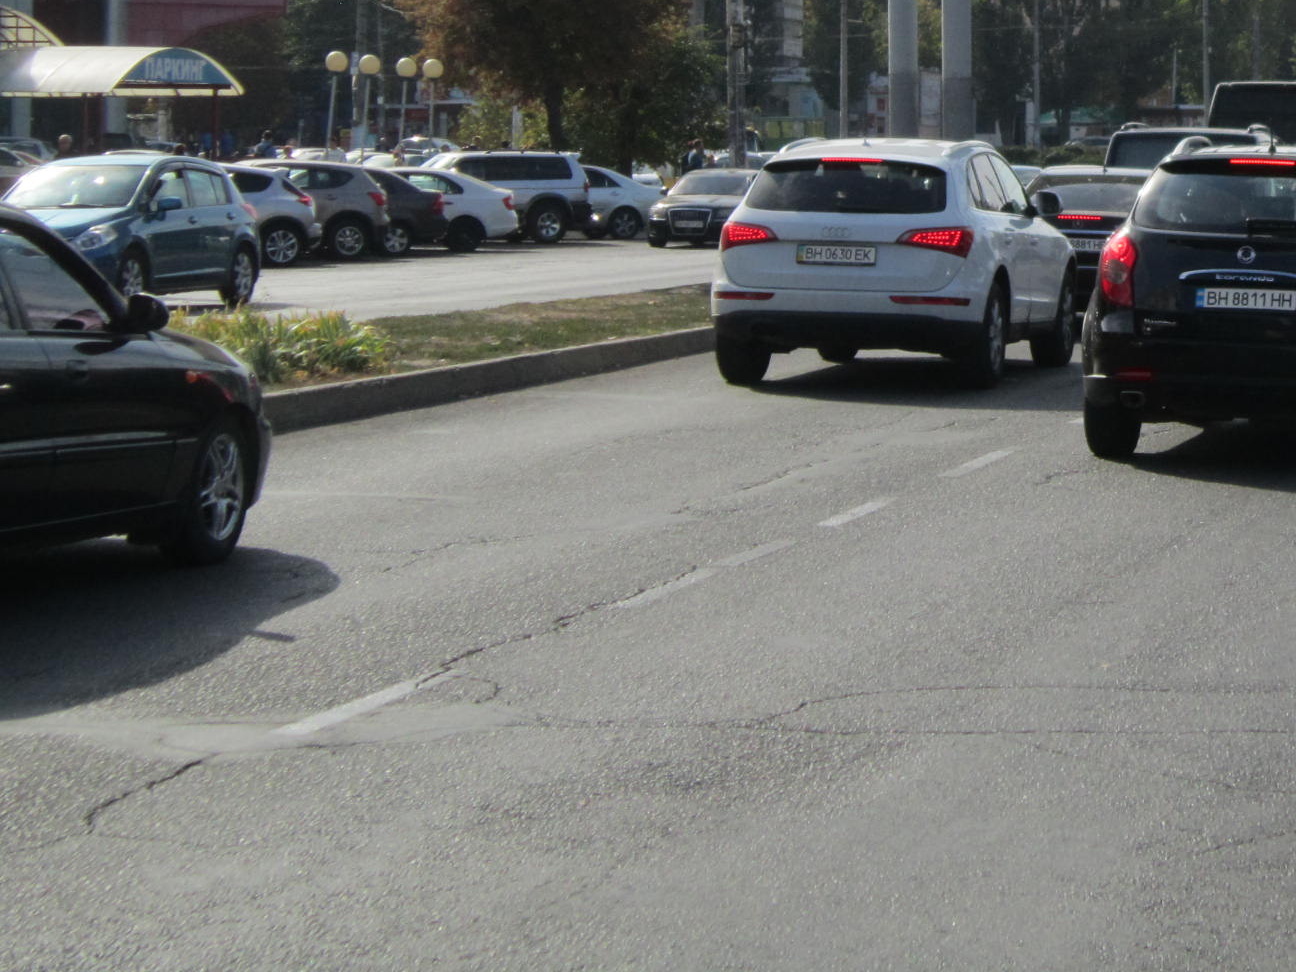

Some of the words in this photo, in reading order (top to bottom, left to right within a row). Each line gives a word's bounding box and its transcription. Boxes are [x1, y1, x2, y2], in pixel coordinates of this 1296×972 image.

[144, 57, 207, 81] ПАРКИНГ
[805, 247, 822, 260] BH
[825, 248, 852, 260] 0630
[855, 249, 871, 260] EK
[1207, 291, 1228, 306] BH
[1233, 292, 1267, 306] 8811
[1272, 293, 1293, 308] HH
